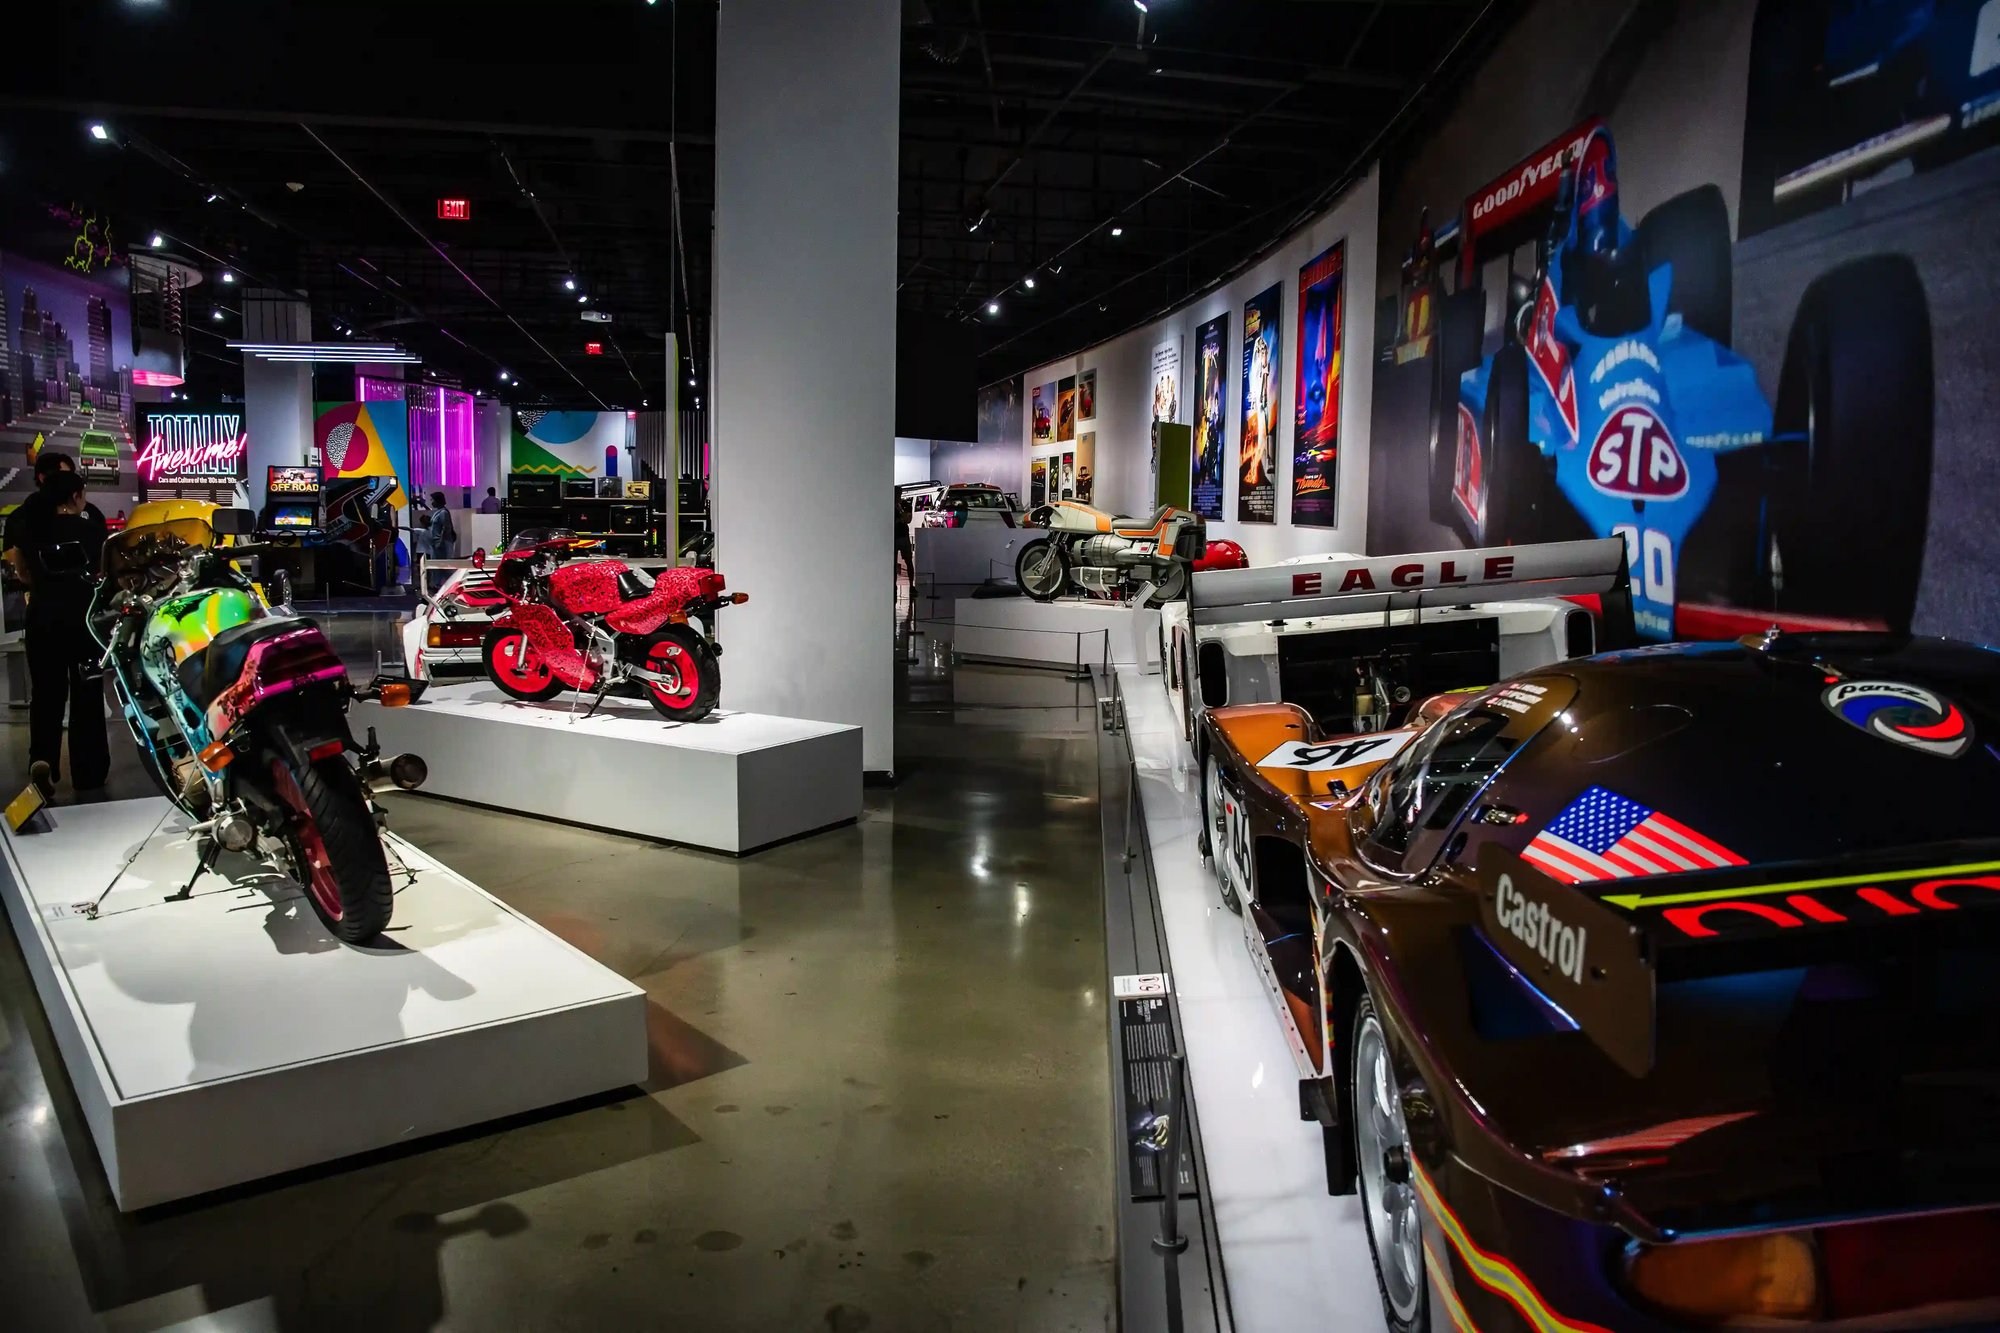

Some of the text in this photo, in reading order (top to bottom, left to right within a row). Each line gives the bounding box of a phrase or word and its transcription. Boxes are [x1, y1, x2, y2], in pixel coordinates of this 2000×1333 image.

[443, 200, 465, 217] EXIT
[136, 432, 248, 481] Awesome!
[147, 414, 240, 475] TOTALLY
[1596, 412, 1678, 486] STP
[270, 483, 319, 492] OFF ROAD
[1292, 556, 1514, 596] EAGLE
[1496, 873, 1586, 985] Castrol
